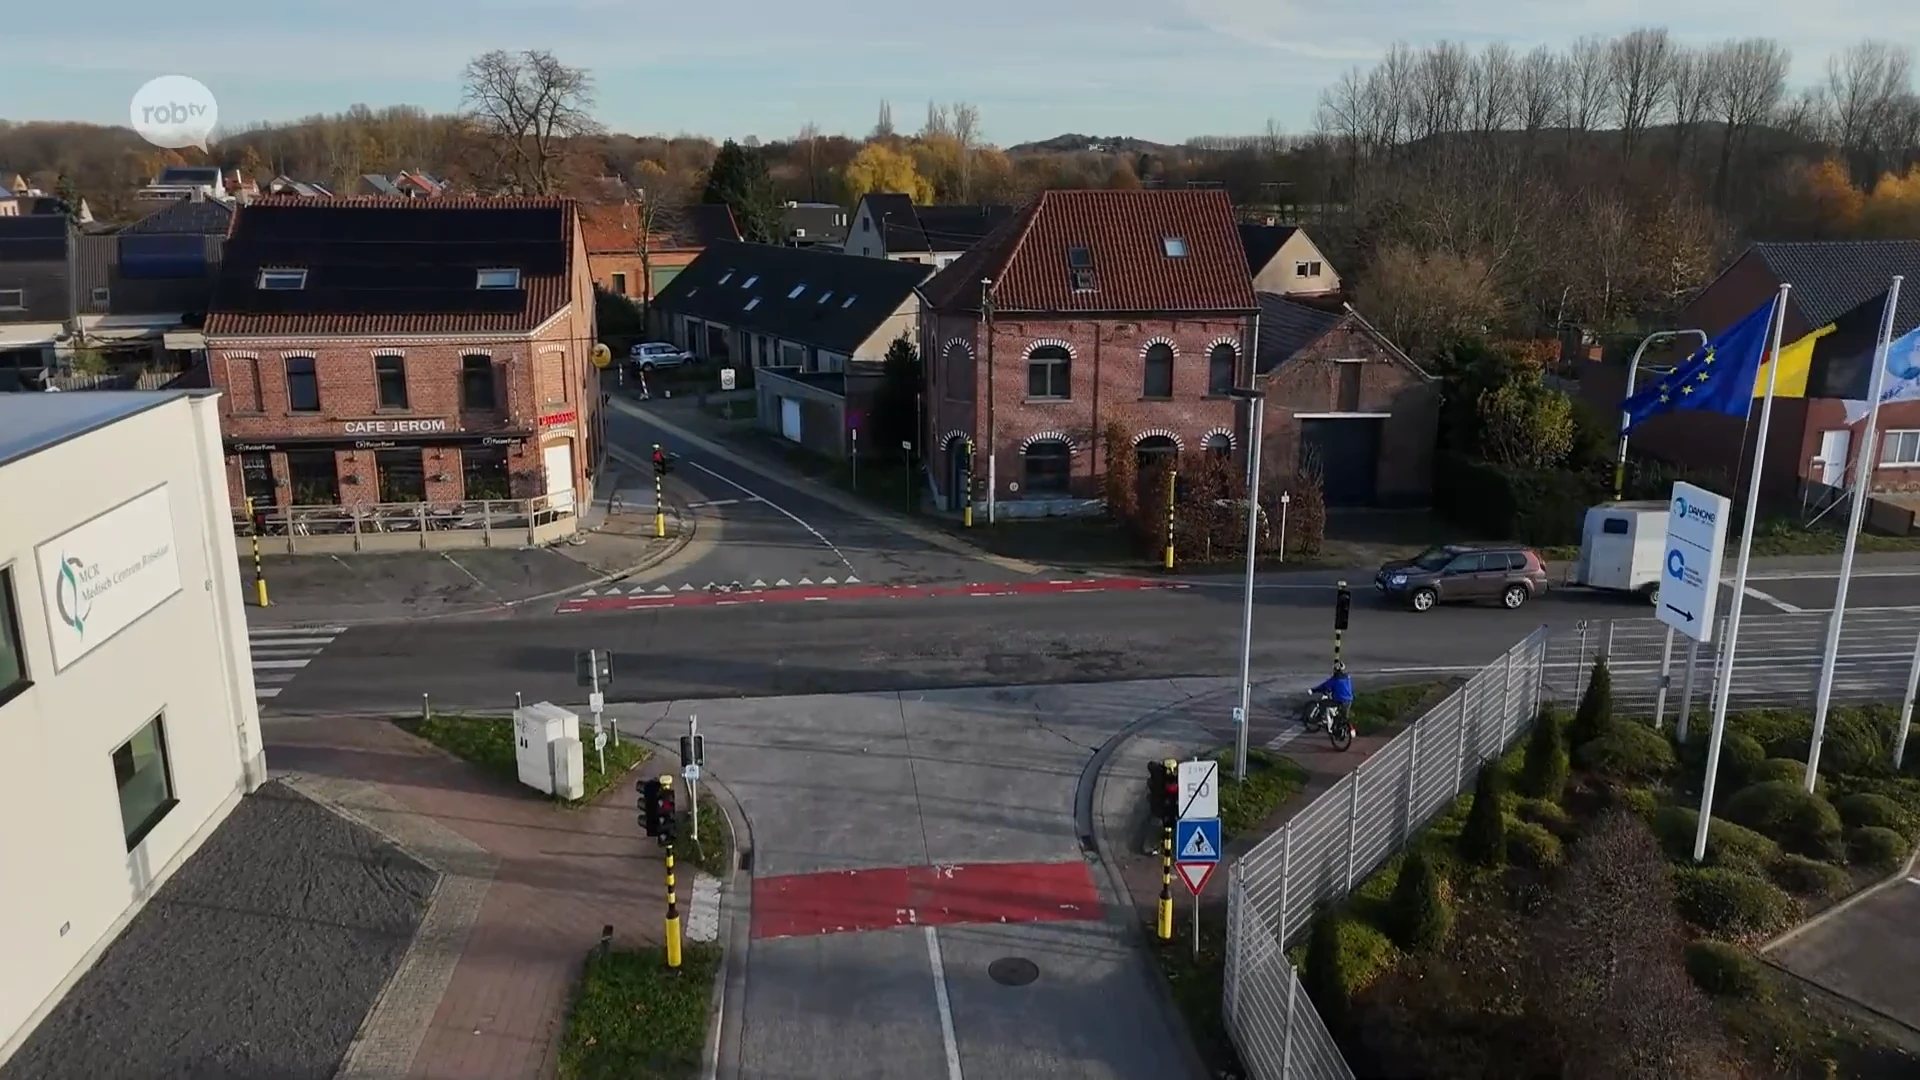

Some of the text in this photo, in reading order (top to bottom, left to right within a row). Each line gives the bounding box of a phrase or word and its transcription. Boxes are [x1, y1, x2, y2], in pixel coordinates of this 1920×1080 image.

[344, 419, 446, 433] CAFE JEROM
[79, 563, 101, 583] MCR
[81, 577, 112, 601] Medisch
[1187, 783, 1210, 799] 50
